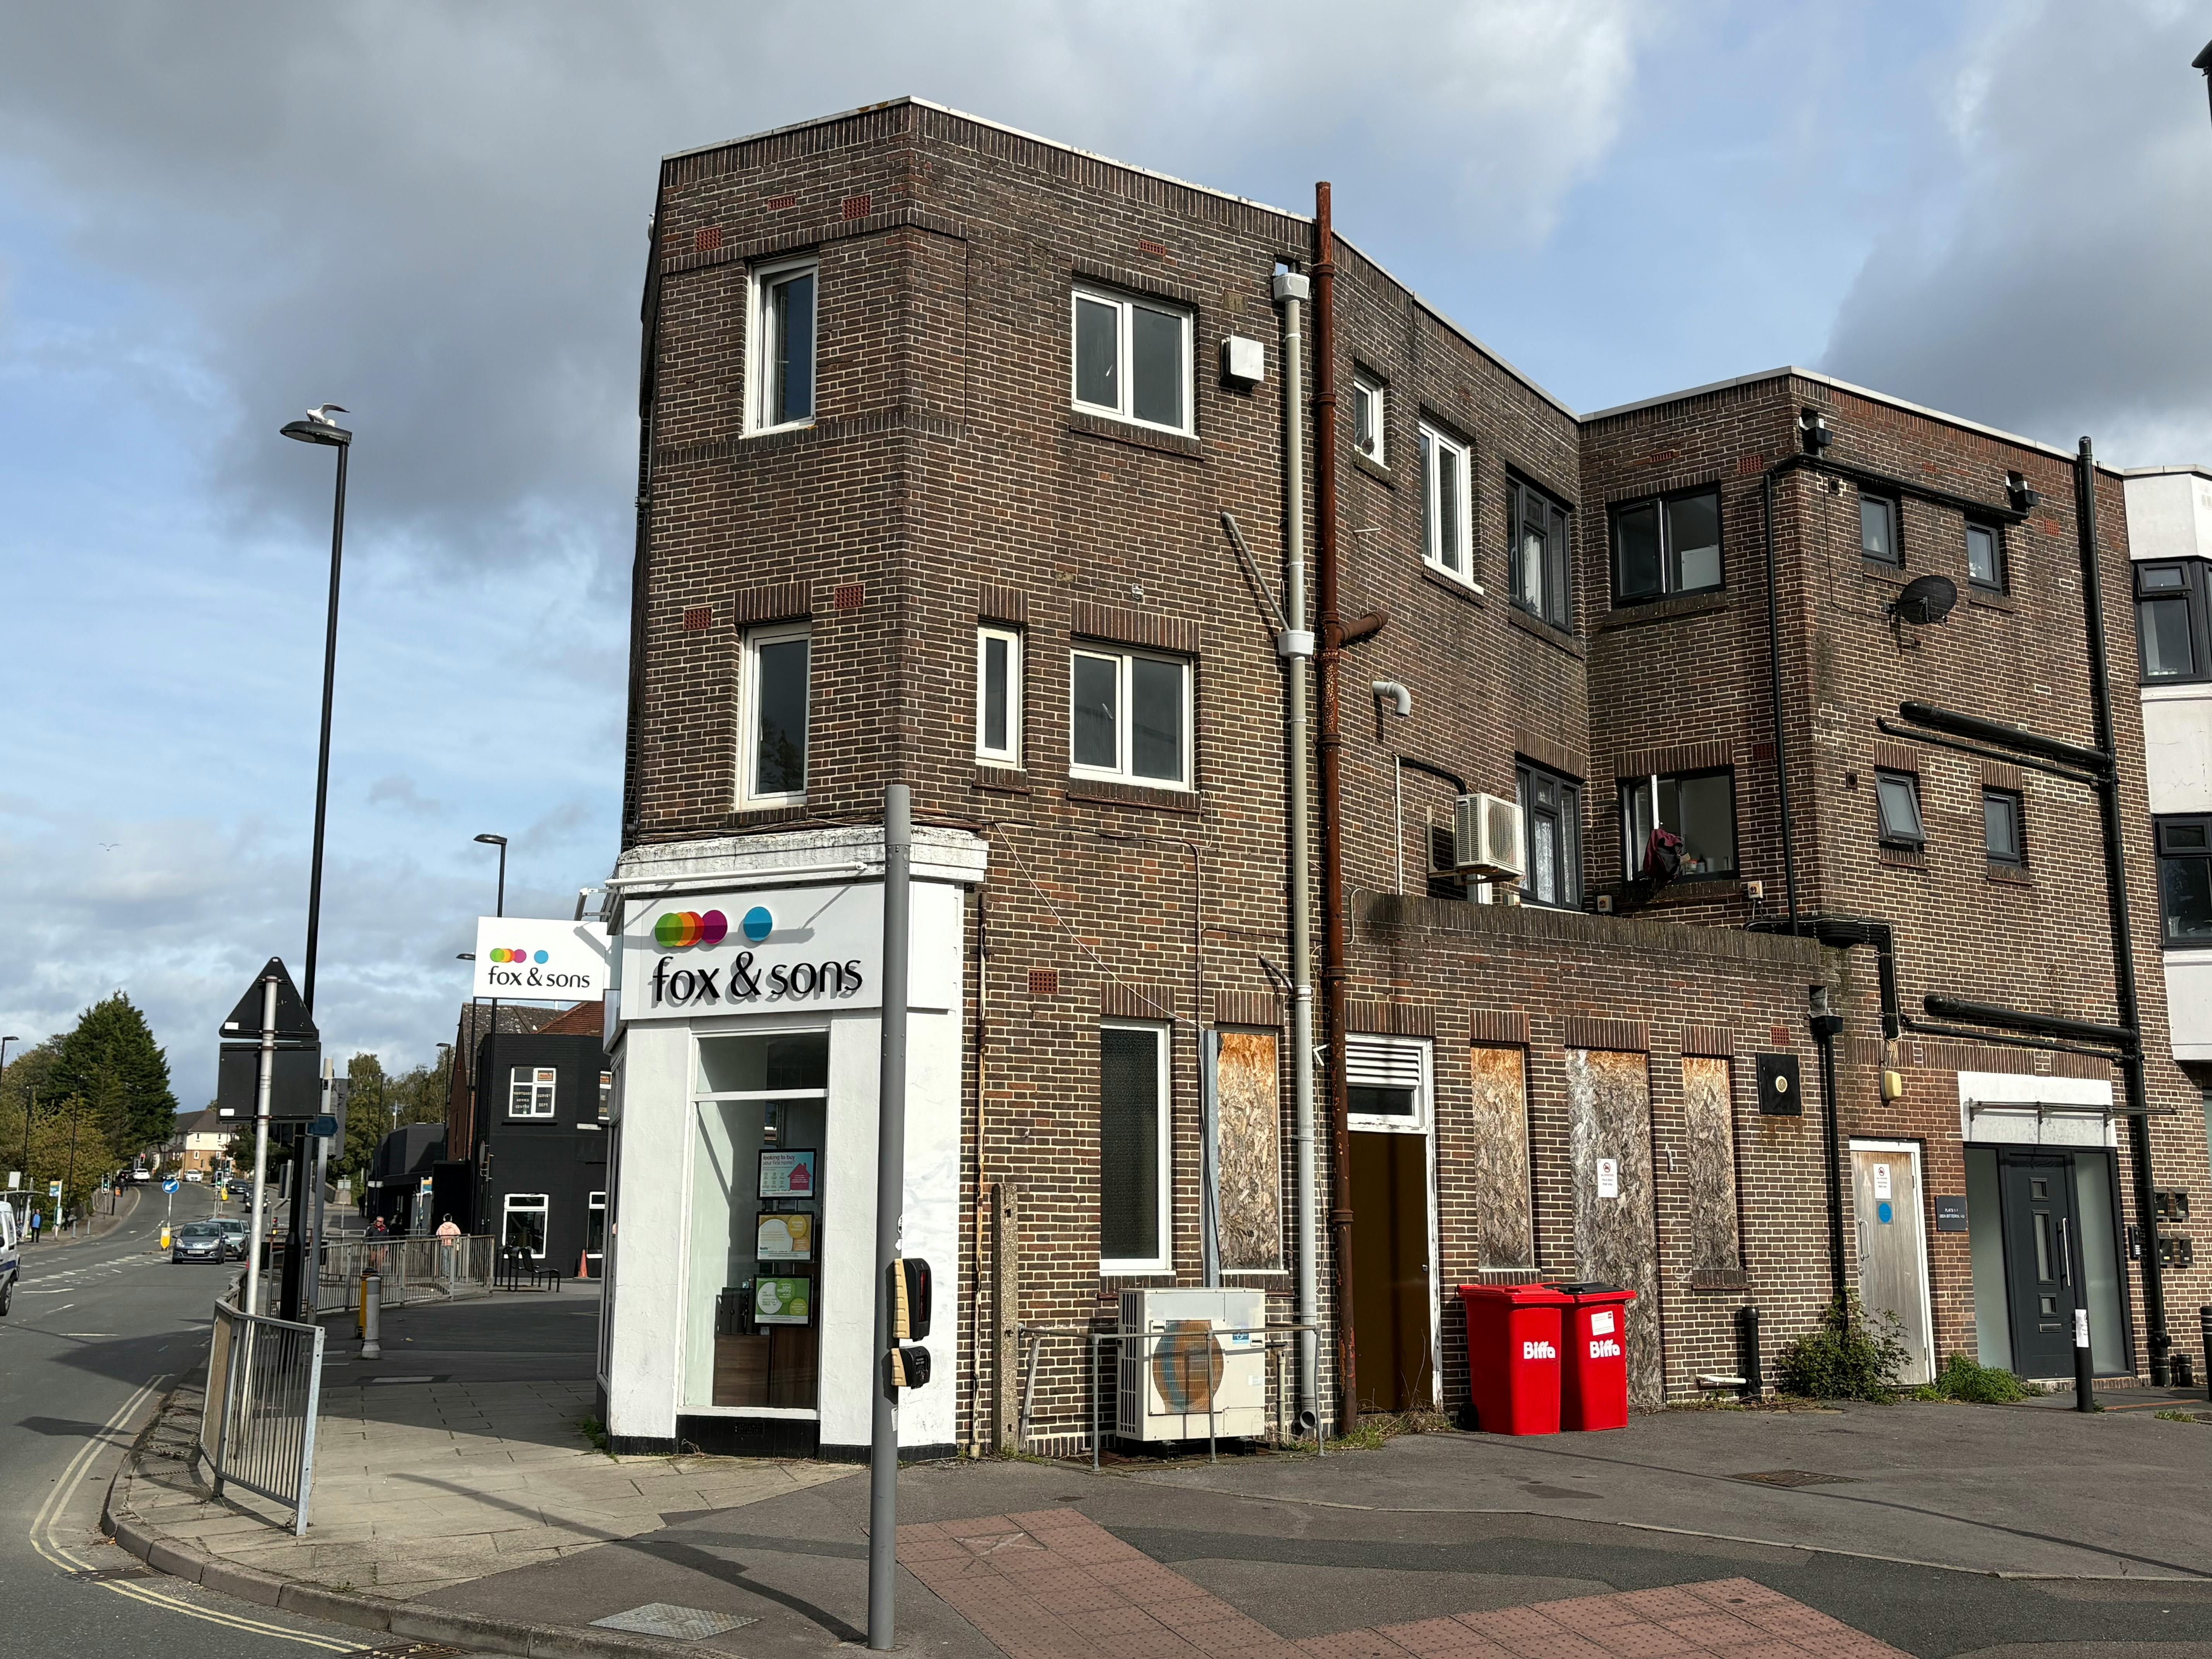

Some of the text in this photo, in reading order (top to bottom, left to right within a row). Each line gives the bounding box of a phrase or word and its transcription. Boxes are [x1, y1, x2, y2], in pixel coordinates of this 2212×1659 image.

[488, 966, 590, 988] fox & sons
[653, 951, 863, 1001] fox & sons
[1523, 1341, 1556, 1360] Biffa
[1589, 1339, 1621, 1359] Biffa
